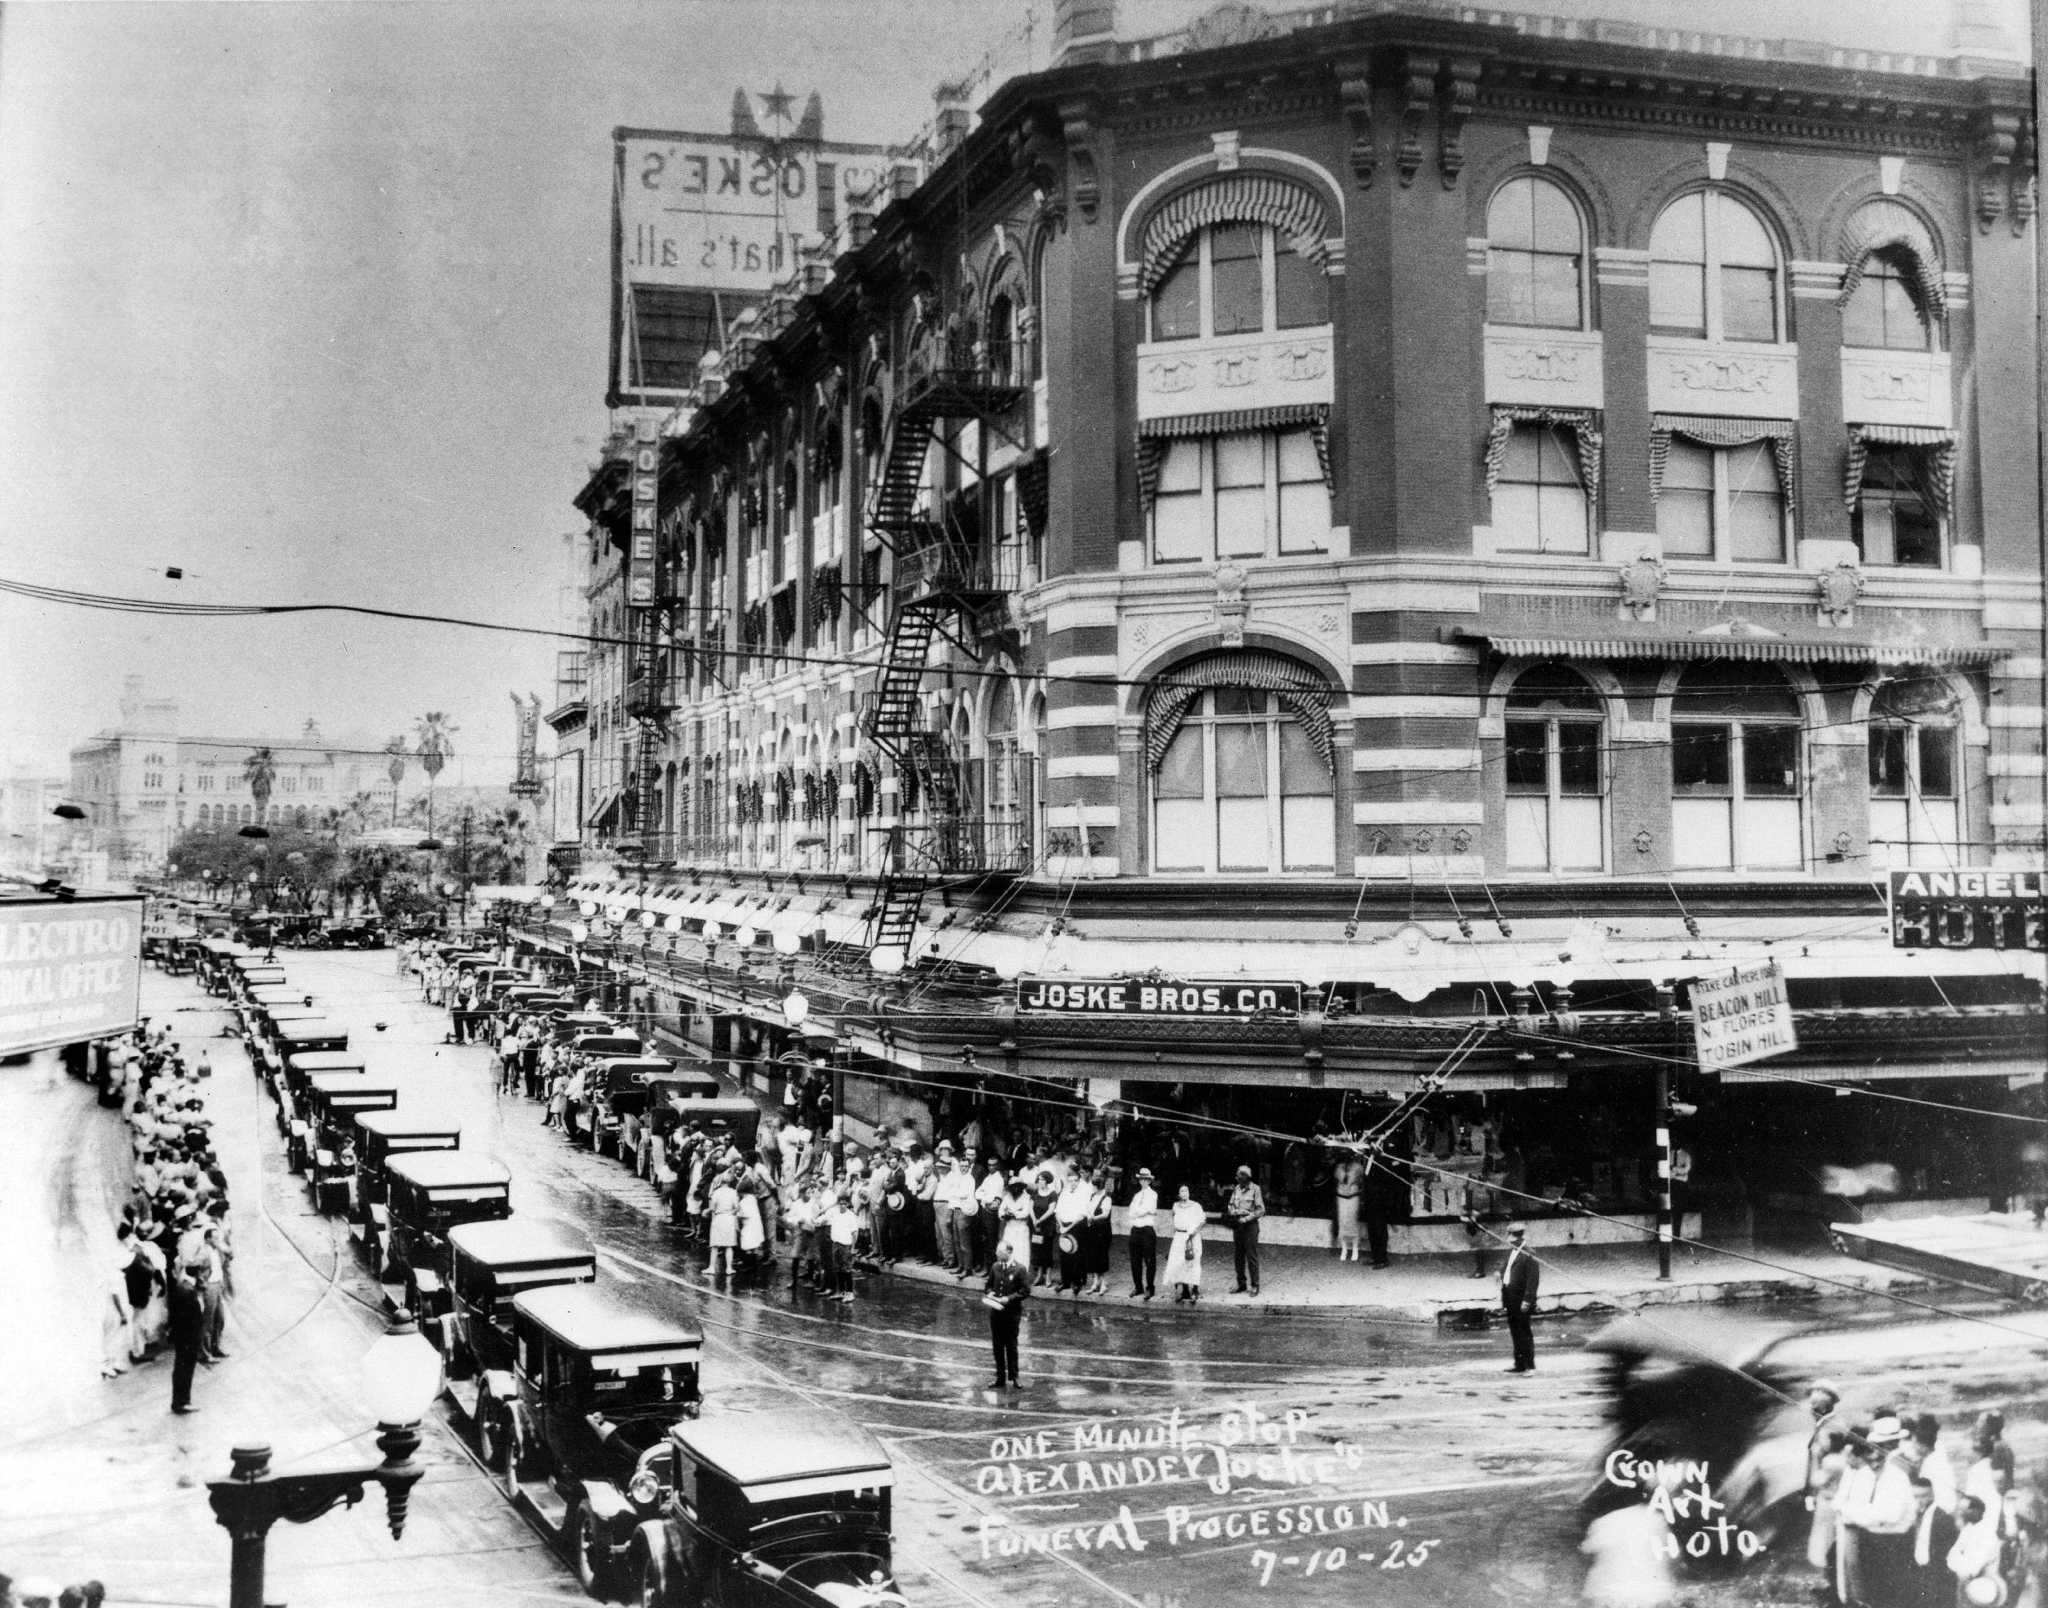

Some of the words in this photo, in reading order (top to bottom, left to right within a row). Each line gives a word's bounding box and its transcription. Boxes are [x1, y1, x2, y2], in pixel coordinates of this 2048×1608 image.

[1028, 984, 1126, 1010] JOSKE
[1140, 986, 1230, 1012] BROS.
[1699, 993, 1750, 1024] BEACON
[1723, 1008, 1776, 1036] FLORES
[1702, 1039, 1751, 1064] TOBIN
[1757, 1029, 1789, 1050] HILL
